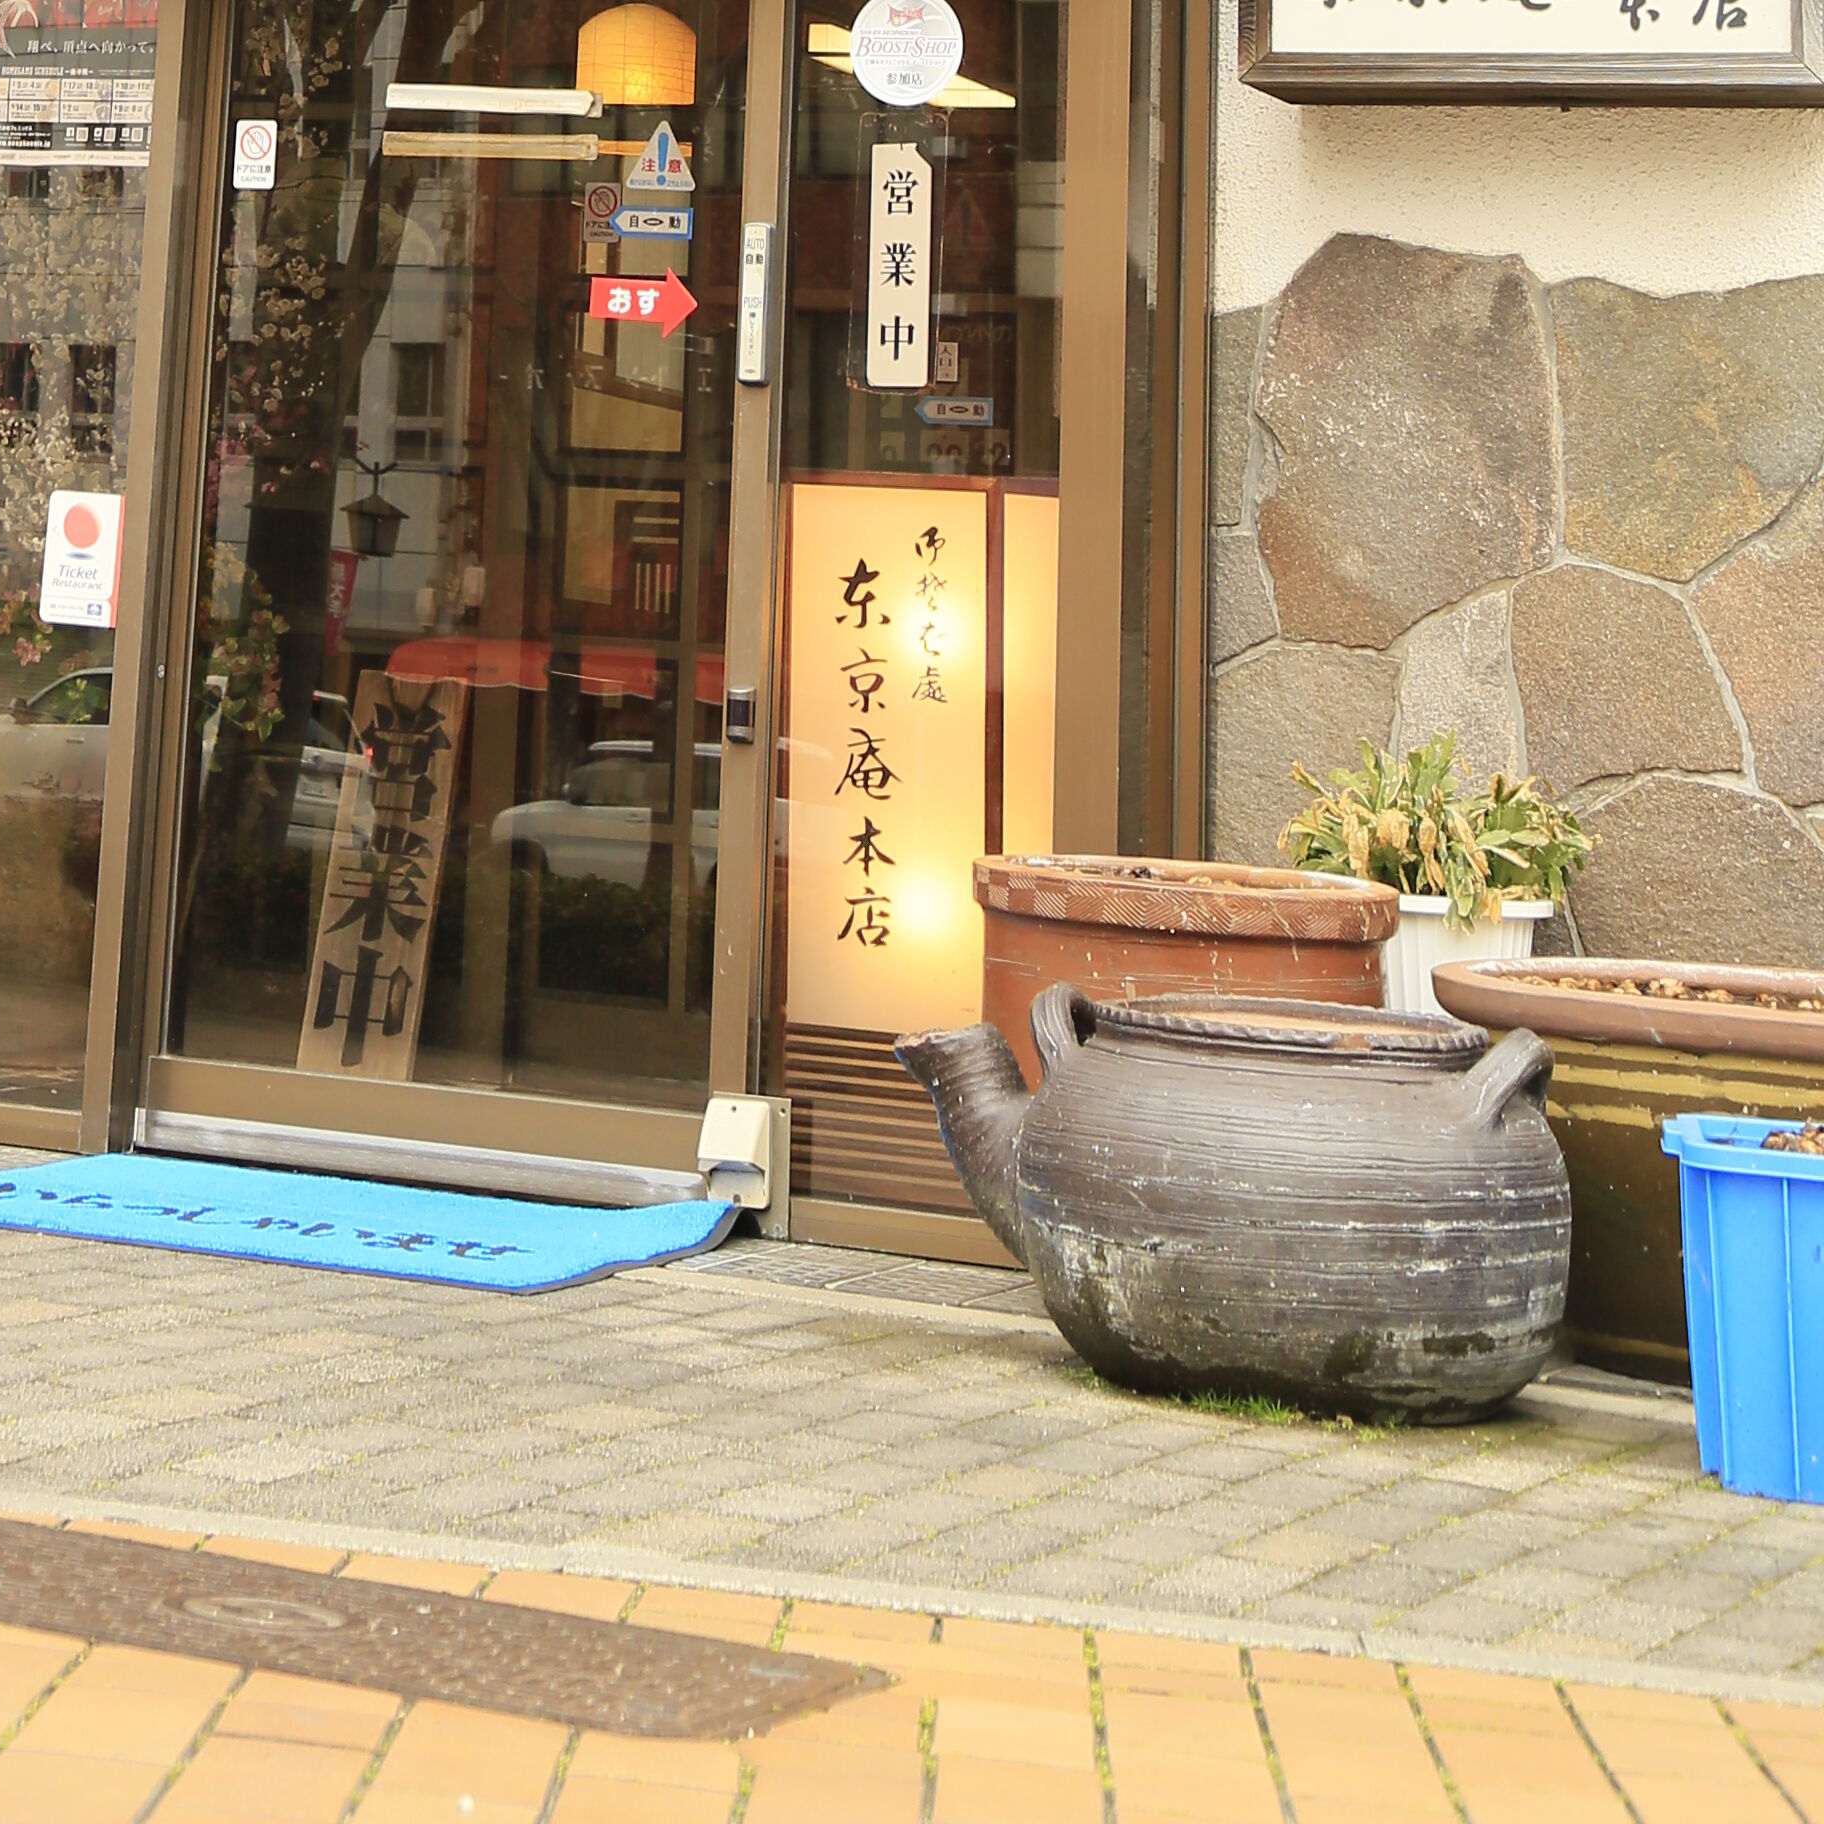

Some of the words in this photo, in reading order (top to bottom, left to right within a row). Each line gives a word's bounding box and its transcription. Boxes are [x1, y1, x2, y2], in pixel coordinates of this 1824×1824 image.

[887, 72, 923, 85] 参加店
[746, 238, 765, 250] AUTO
[745, 254, 764, 264] 自動
[880, 169, 919, 362] 営業中
[607, 287, 660, 316] おす
[743, 297, 763, 308] PUSH
[58, 564, 99, 581] Ticket
[834, 557, 903, 948] 東京庵本店
[313, 694, 452, 1068] 営業中
